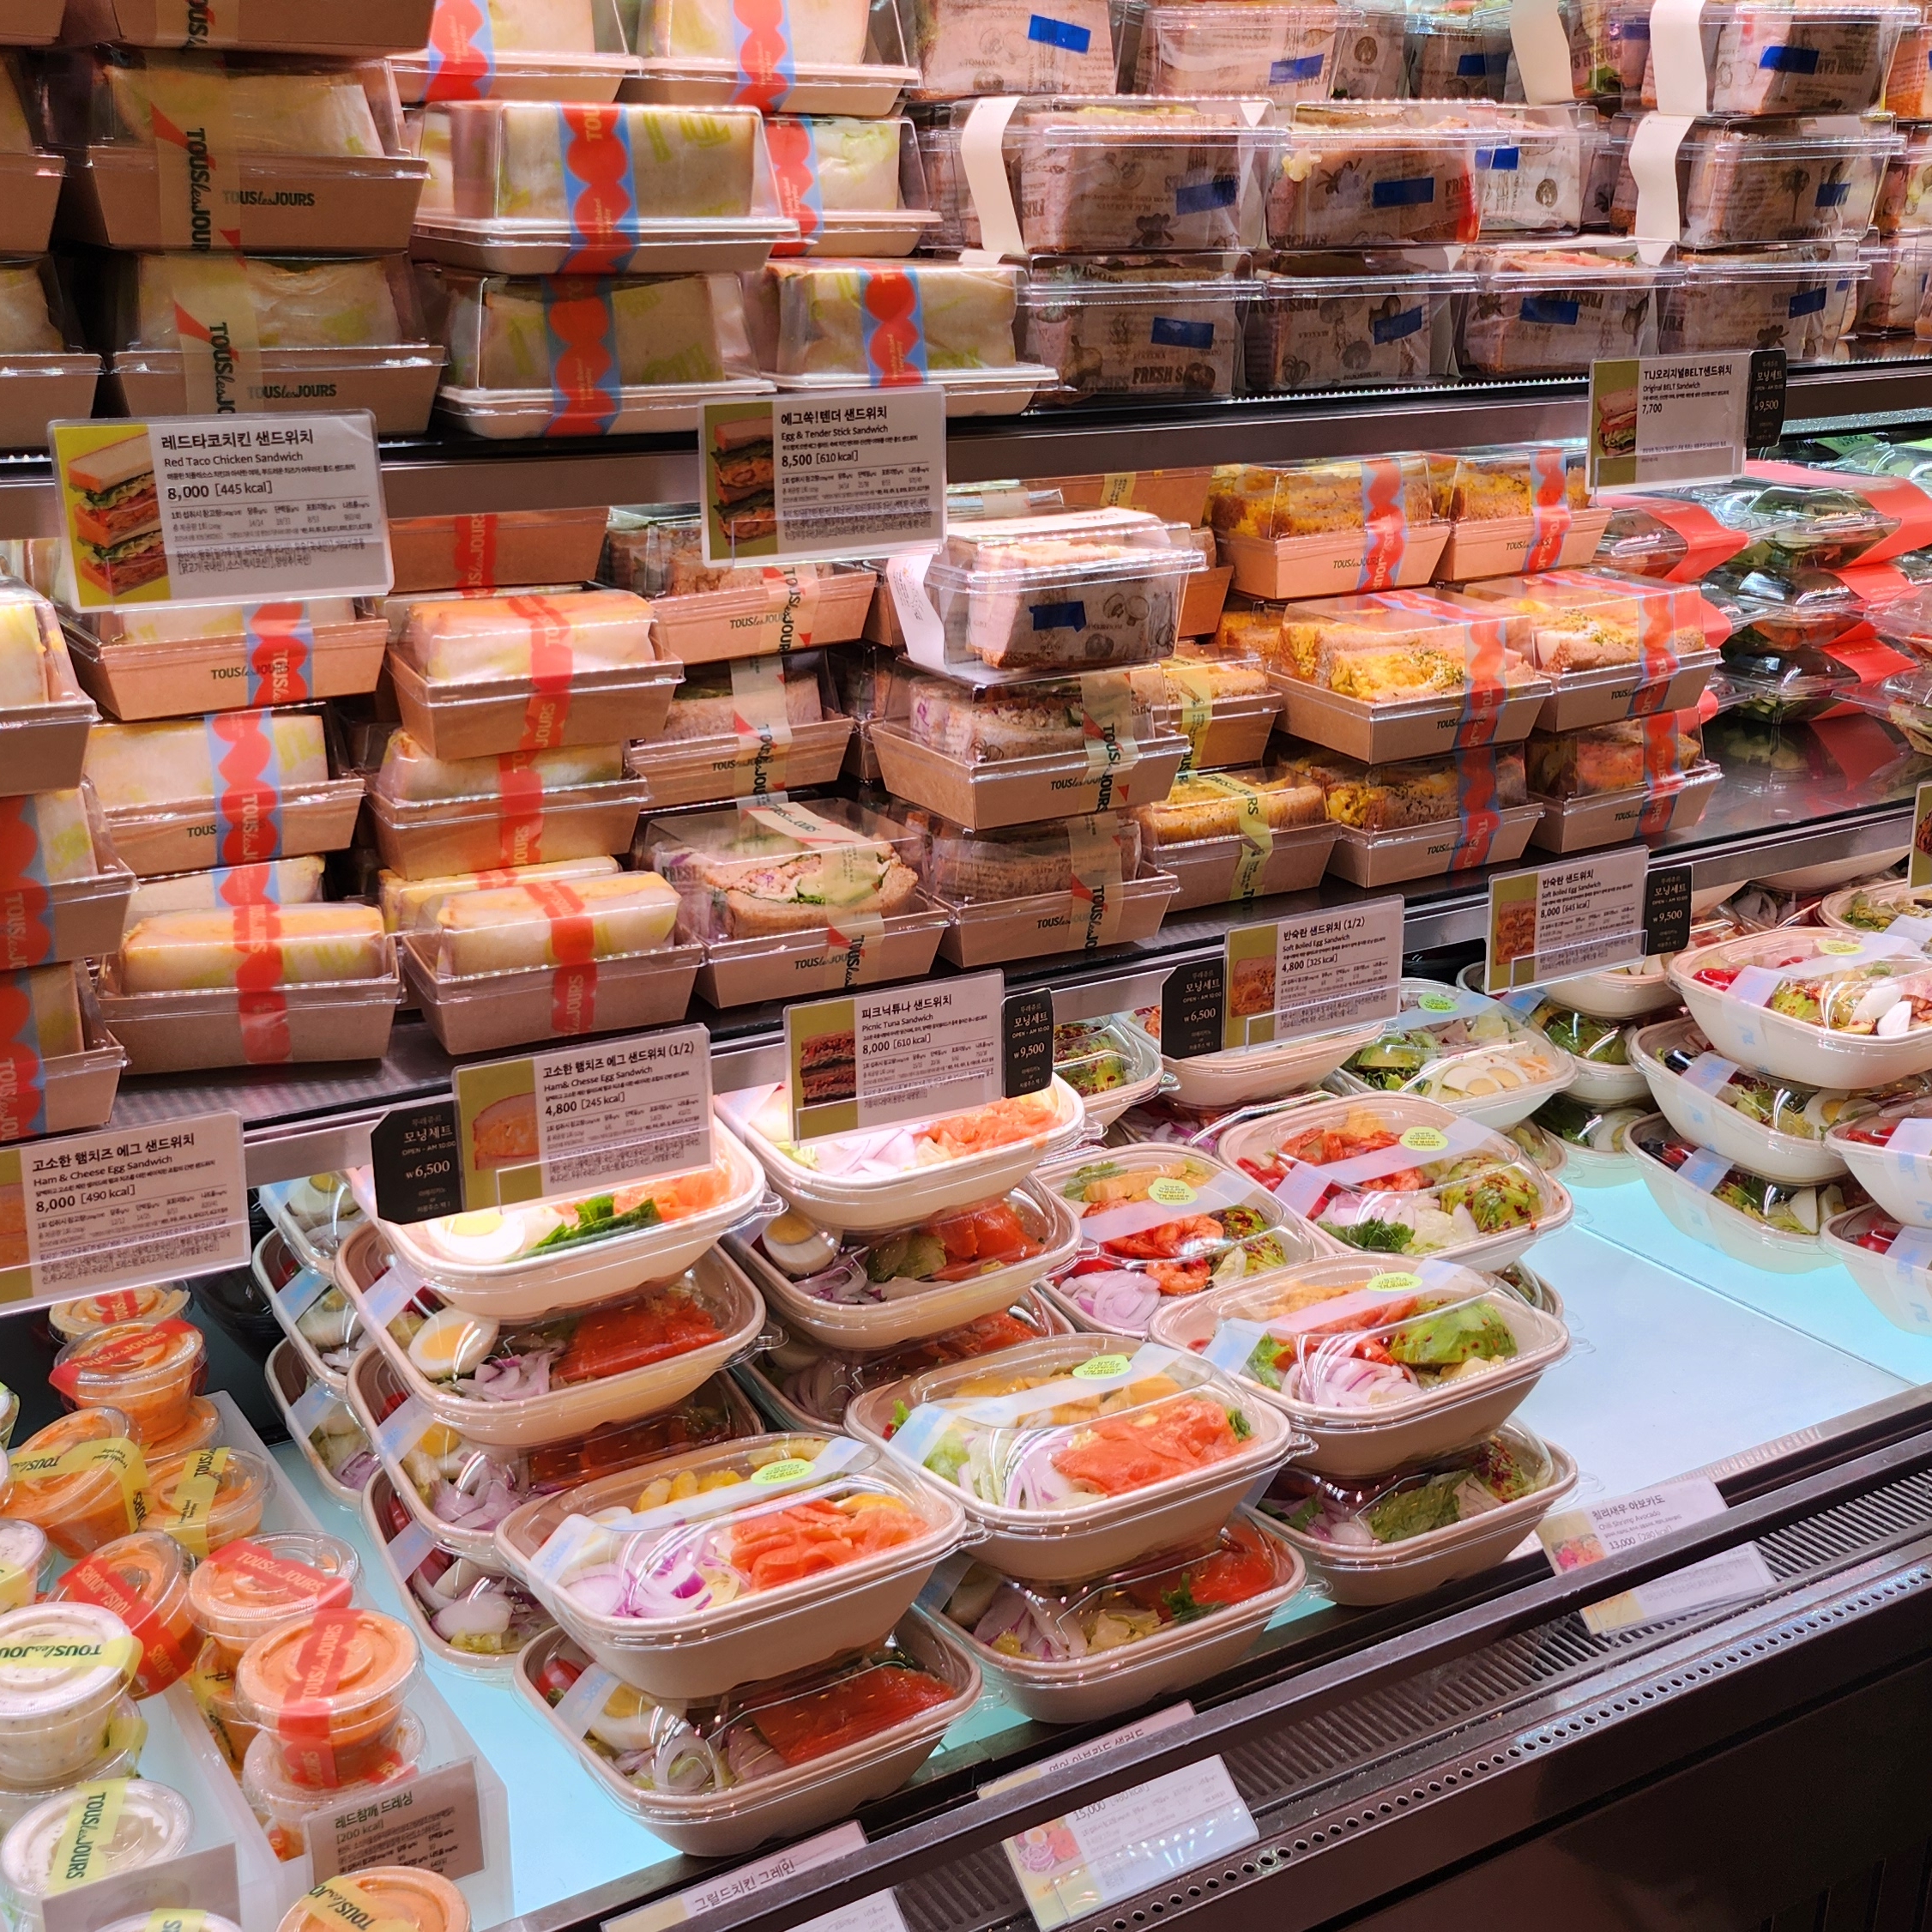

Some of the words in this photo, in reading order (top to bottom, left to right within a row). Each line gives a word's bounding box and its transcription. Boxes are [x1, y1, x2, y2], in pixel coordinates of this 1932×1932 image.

[223, 190, 316, 207] TOUSlesJOURS
[1132, 367, 1173, 384] FRESH
[1757, 369, 1783, 383] 모닝세트
[247, 384, 337, 400] TOUSlesJOURS
[1663, 383, 1676, 391] BELT
[1676, 382, 1700, 390] Sandwich
[844, 406, 888, 421] 샌드위치
[1641, 403, 1663, 415] 7,700
[161, 431, 251, 451] 레드타코치킨
[256, 429, 314, 448] 샌드위치
[781, 432, 795, 443] Egg
[796, 431, 804, 439] &
[805, 429, 831, 439] Tender
[833, 427, 851, 437] Stick
[852, 425, 889, 436] Sandwich
[164, 456, 184, 468] Red
[186, 456, 211, 467] Taco
[213, 453, 253, 465] Chicken
[255, 451, 303, 464] Sandwich
[782, 454, 812, 468] 8,500
[816, 452, 836, 465] [610
[837, 450, 859, 463] kcal]
[167, 485, 209, 500] 8,000
[215, 482, 242, 496] [445
[243, 480, 273, 495] kcal]
[1542, 875, 1564, 890] 반숙란
[1566, 869, 1595, 884] 샌드위치
[1541, 891, 1552, 900] Soft
[1553, 889, 1567, 897] Boiled
[1567, 887, 1577, 896] Egg
[1577, 881, 1602, 893] Sandwich
[1653, 884, 1687, 897] 모닝세트
[1540, 907, 1561, 919] 8,000
[1576, 900, 1591, 910] kcal]
[1283, 927, 1308, 941] 반숙란
[1310, 921, 1342, 936] 샌드위치
[1343, 916, 1366, 931] (1/2)
[1295, 941, 1313, 951] Boiled
[1313, 939, 1323, 949] Egg
[1323, 933, 1350, 945] Sandwich
[1282, 961, 1305, 973] 4,800
[1307, 957, 1322, 969] [325
[1322, 954, 1338, 966] kcal]
[1184, 978, 1221, 993] 모닝세트
[861, 1001, 911, 1019] 피크닉튜나
[914, 994, 953, 1011] 샌드위치
[862, 1022, 882, 1032] Picnic
[883, 1018, 901, 1029] Tuna
[902, 1013, 934, 1026] Sandwich
[1013, 1011, 1048, 1029] 모닝세트
[862, 1041, 890, 1054] 8,000
[893, 1037, 911, 1049] [610
[912, 1033, 932, 1046] kcal]
[542, 1062, 573, 1079] 고소한
[575, 1057, 605, 1073] 햄치즈
[607, 1054, 627, 1067] 에그
[629, 1046, 667, 1065] 샌드위치
[668, 1041, 695, 1060] (1/2)
[543, 1079, 570, 1092] Ham&
[571, 1074, 599, 1088] Chesse
[601, 1072, 615, 1084] Egg
[616, 1065, 654, 1080] Sandwich
[545, 1101, 577, 1117] 4,800
[581, 1096, 602, 1111] [245
[603, 1091, 625, 1108] kcal]
[403, 1125, 453, 1144] 모닝세트
[33, 1153, 72, 1173] 고소한
[75, 1148, 114, 1166] 햄치즈
[117, 1144, 142, 1159] 에그
[145, 1133, 196, 1154] 샌드위치
[401, 1147, 421, 1156] OPEN
[438, 1141, 456, 1150] 10:00
[33, 1175, 57, 1188] Ham
[59, 1174, 68, 1182] &
[70, 1168, 106, 1181] Cheese
[107, 1163, 126, 1176] Egg
[127, 1156, 173, 1170] Sandwich
[36, 1196, 76, 1213] 8,000
[81, 1191, 107, 1204] [490
[109, 1184, 136, 1200] kcal]
[72, 1331, 167, 1369] TOUSlesJOURS
[1591, 1503, 1628, 1523] 칠리새우
[1627, 1494, 1666, 1512] 아보카도
[1634, 1509, 1662, 1522] Avocado
[1609, 1537, 1637, 1550] 13,000
[235, 1550, 327, 1595] TOUSlesJOURS
[75, 1564, 133, 1618] TOUSlesJOURS
[300, 1623, 344, 1701] TOUSlesJOURS
[334, 1804, 379, 1829] 레드참깨
[380, 1790, 414, 1814] 드레싱
[65, 1792, 106, 1880] TOUSlesJOURS
[336, 1829, 360, 1845] [200
[362, 1820, 385, 1834] kcal]
[694, 1877, 758, 1912] 그릴드치킨
[758, 1858, 796, 1887] 그레인
